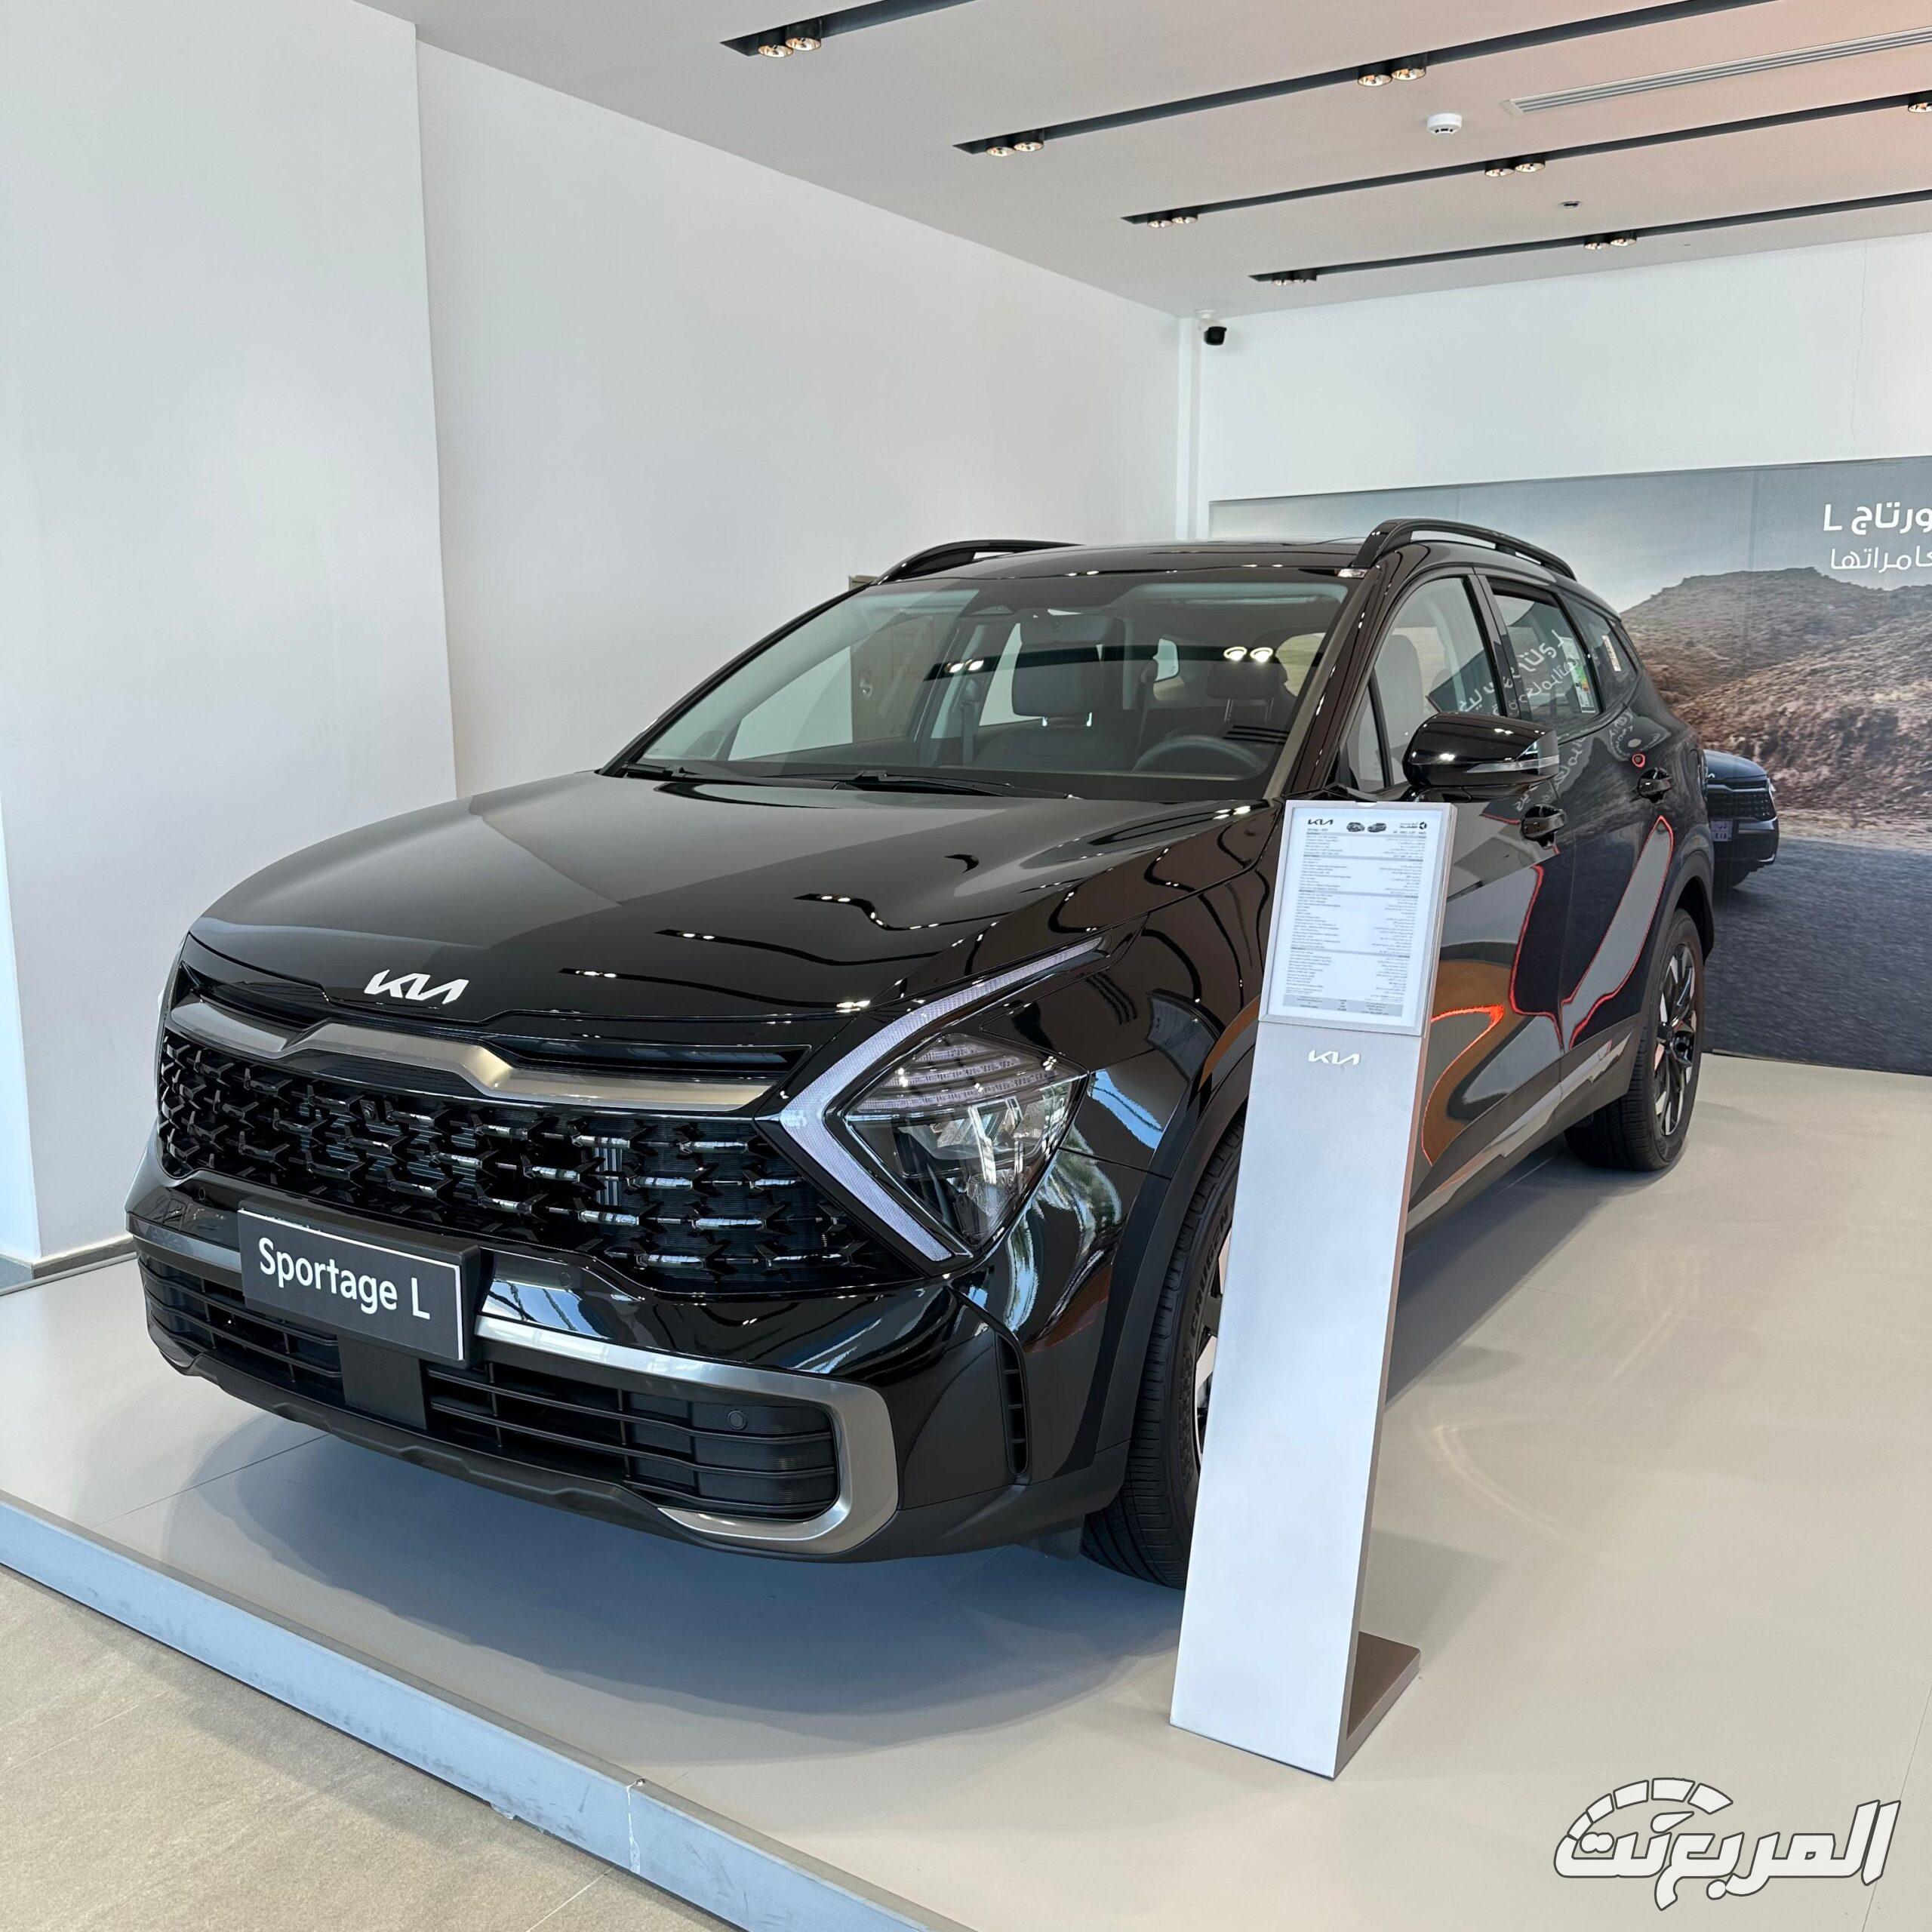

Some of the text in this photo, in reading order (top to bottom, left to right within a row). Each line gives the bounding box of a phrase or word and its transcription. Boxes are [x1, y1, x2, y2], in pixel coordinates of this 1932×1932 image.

[1823, 503, 1843, 531] L
[364, 969, 469, 1004] KIA
[1308, 1049, 1361, 1066] KIA
[258, 1237, 430, 1320] Sportage L
